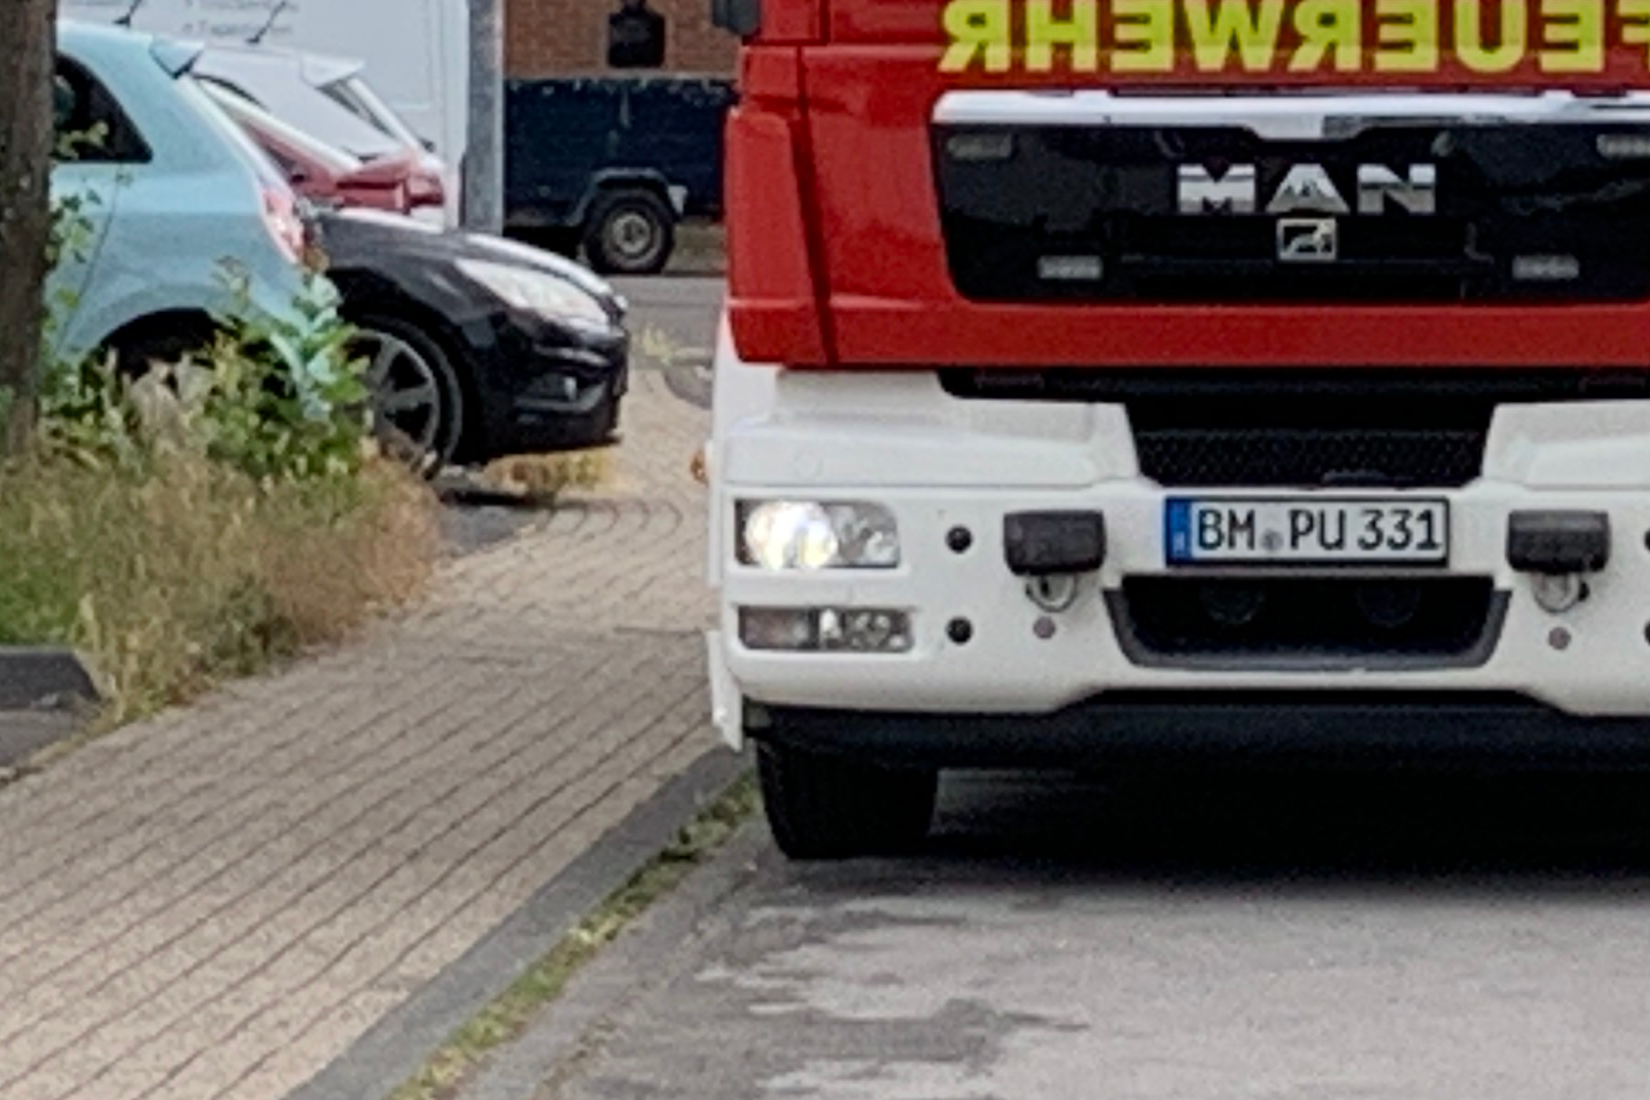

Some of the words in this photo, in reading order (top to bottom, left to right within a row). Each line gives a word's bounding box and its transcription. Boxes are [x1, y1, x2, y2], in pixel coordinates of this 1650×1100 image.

[1177, 163, 1437, 215] MAN
[1197, 508, 1256, 551] BM
[1288, 508, 1348, 551] PU
[1356, 508, 1441, 551] 331
